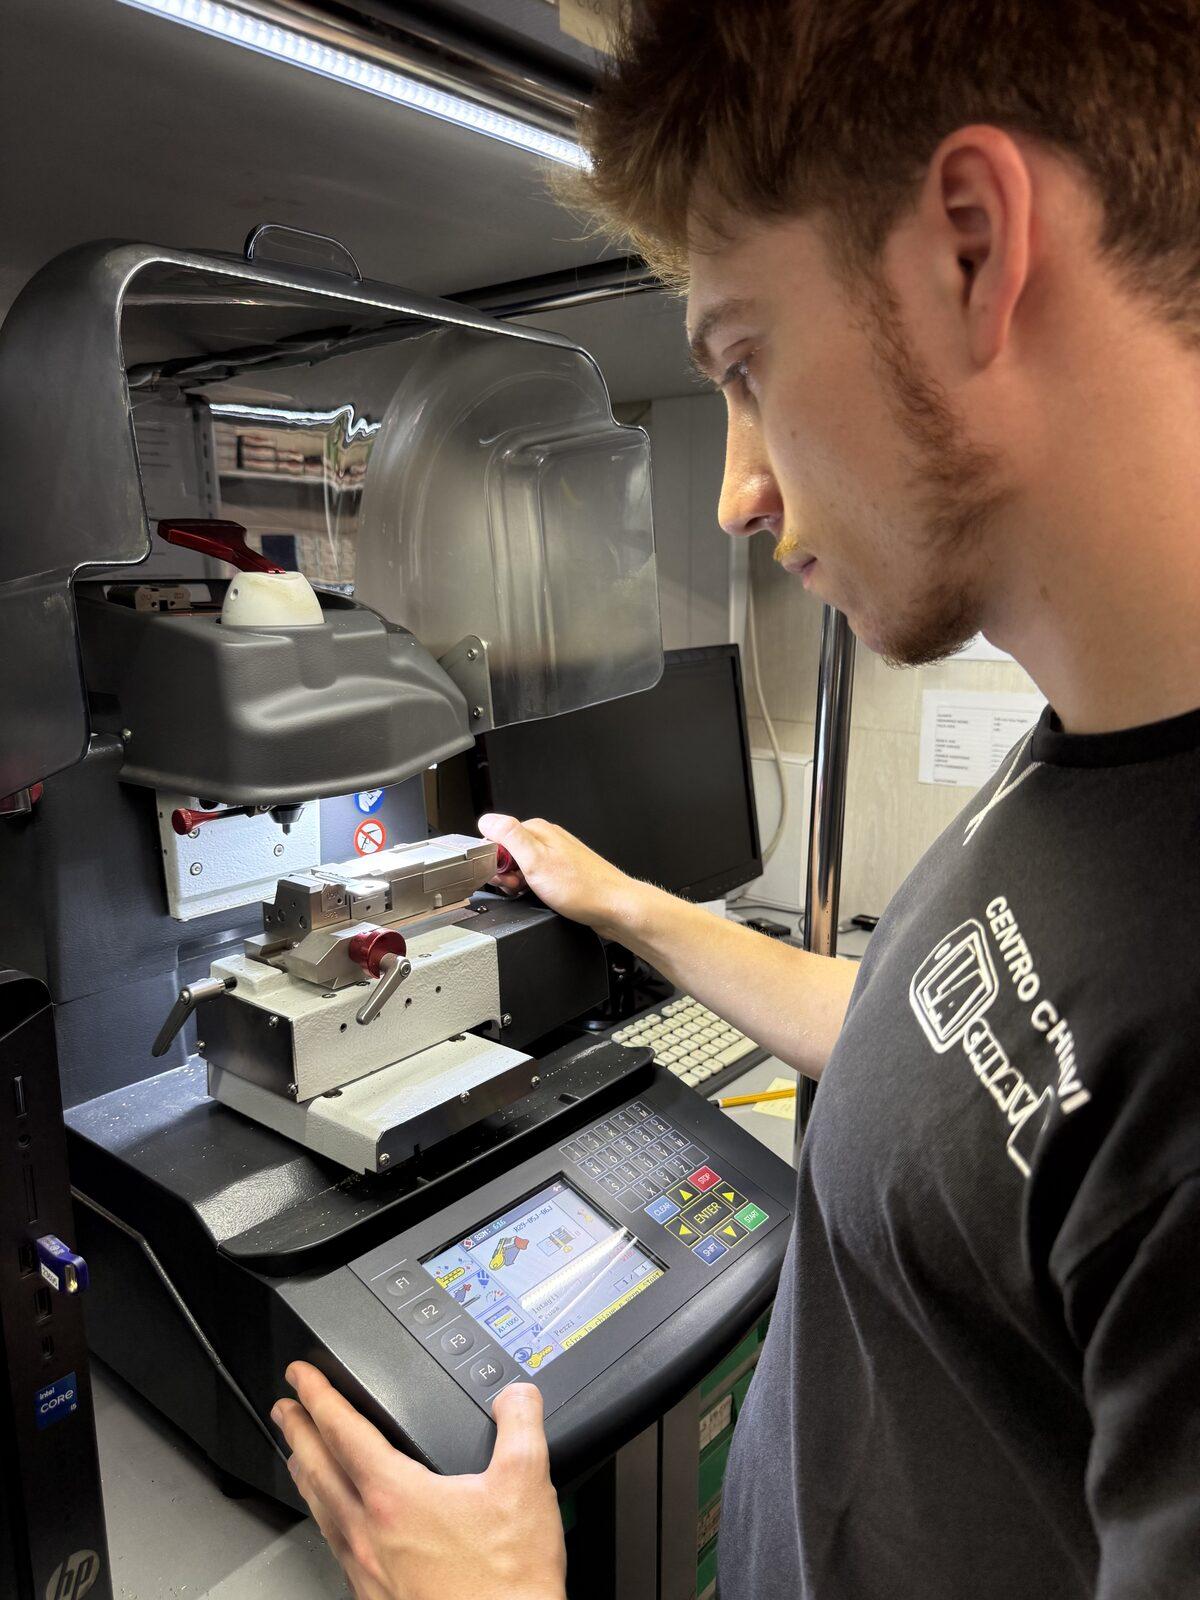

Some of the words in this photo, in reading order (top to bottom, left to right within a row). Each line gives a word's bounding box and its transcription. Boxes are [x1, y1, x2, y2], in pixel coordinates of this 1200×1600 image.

[985, 895, 1040, 1002] CENTRO
[697, 1172, 710, 1184] STOP
[654, 1202, 672, 1216] CLEAR
[694, 1202, 722, 1224] ENTER
[744, 1210, 760, 1224] START
[702, 1242, 718, 1257] SHIFT
[395, 1276, 410, 1288] F1
[422, 1304, 438, 1318] F2
[554, 1320, 575, 1337] Pezzi
[450, 1334, 466, 1348] F3
[478, 1364, 496, 1380] F4
[40, 1386, 55, 1400] intel
[48, 1551, 98, 1600] hp
